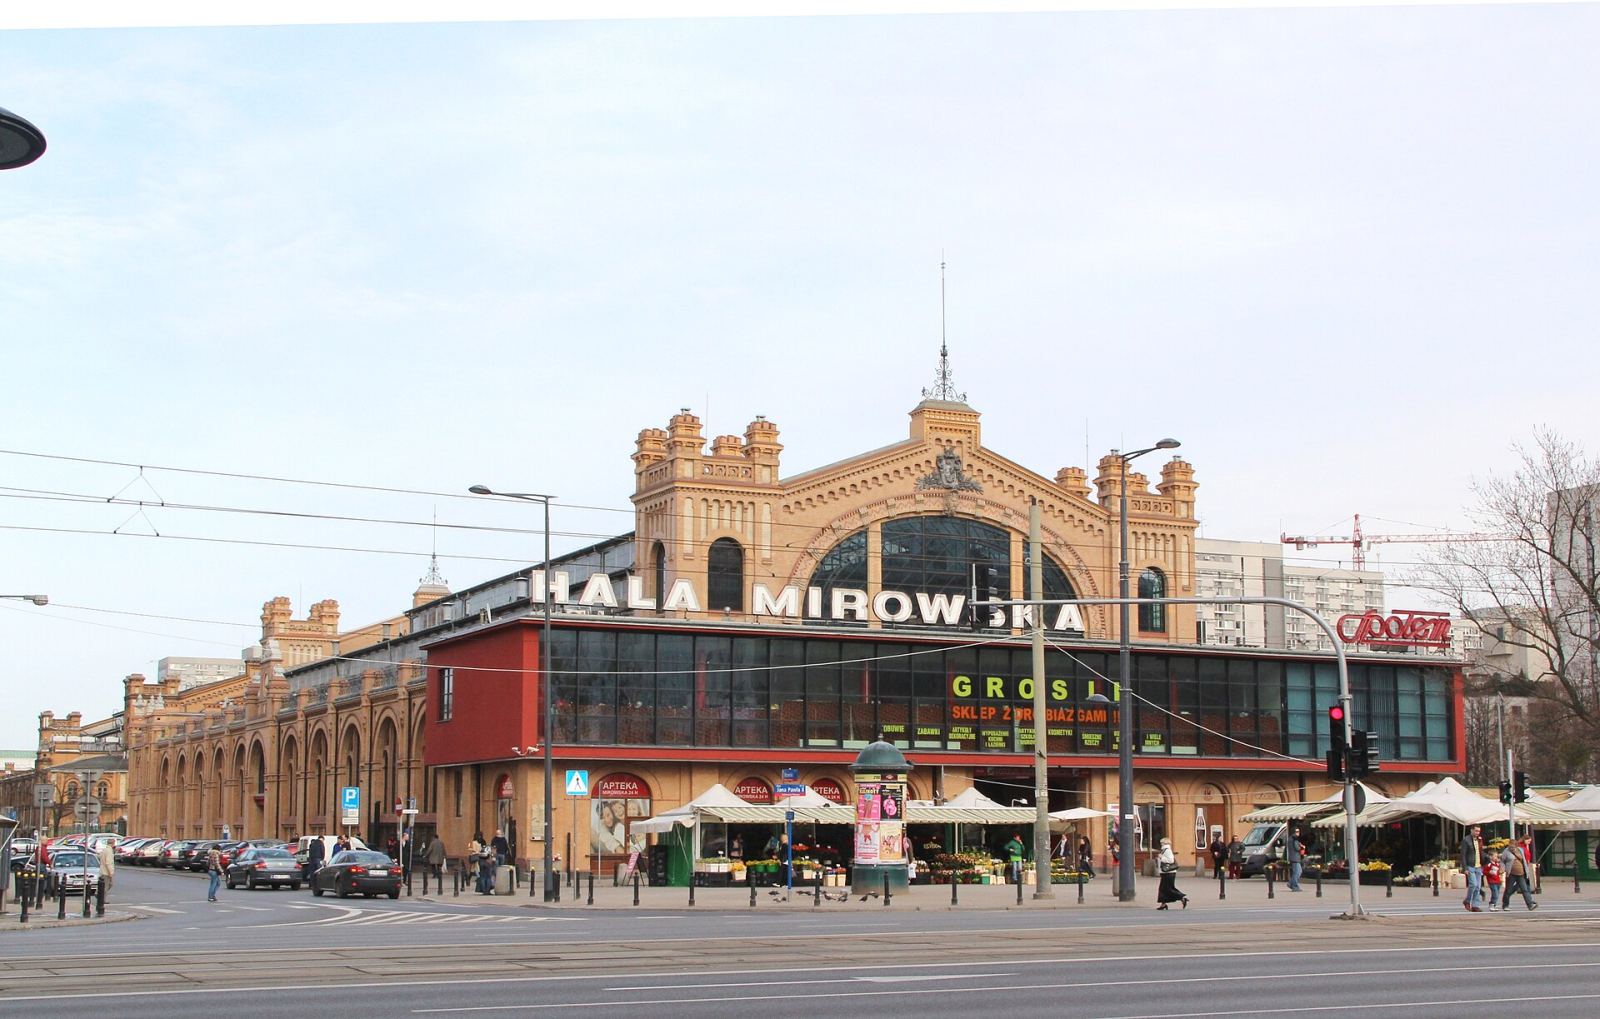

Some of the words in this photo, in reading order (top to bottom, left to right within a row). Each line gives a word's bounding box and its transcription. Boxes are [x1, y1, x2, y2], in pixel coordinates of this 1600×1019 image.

[532, 569, 701, 612] HALA
[952, 706, 996, 721] SKLEP
[602, 781, 639, 790] APTEKA
[734, 786, 769, 794] APTEKA
[345, 789, 357, 803] P
